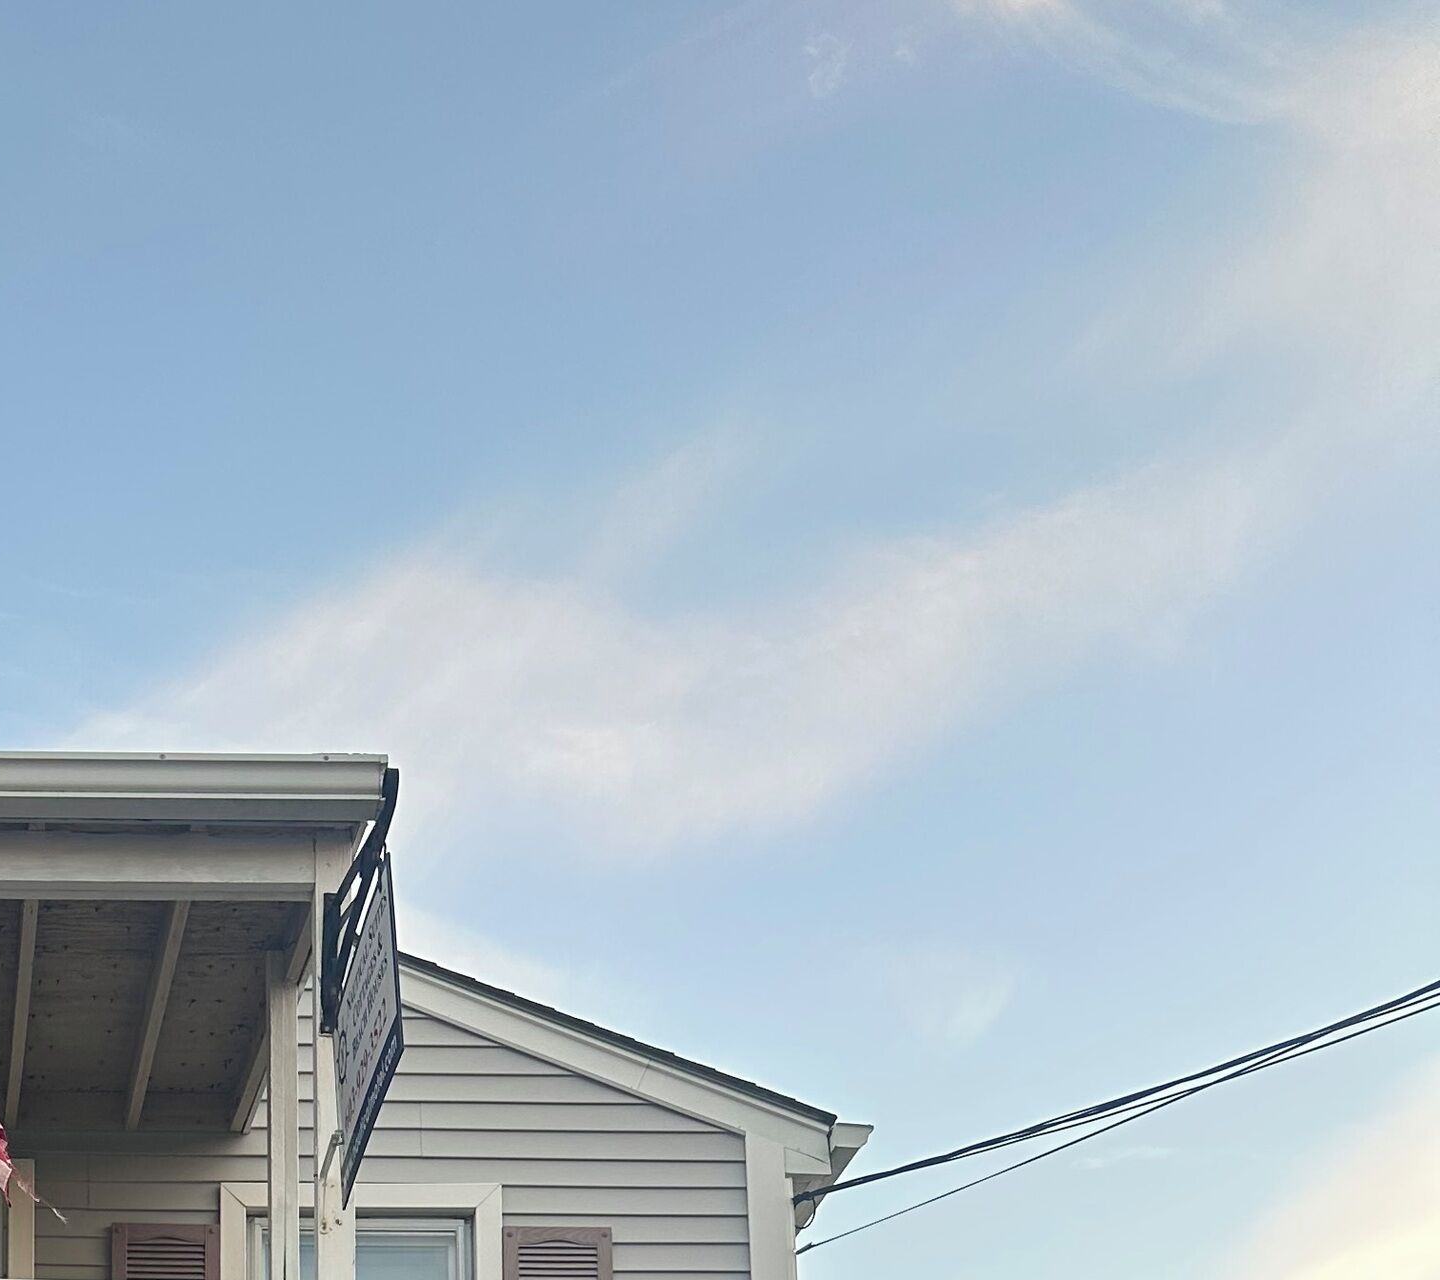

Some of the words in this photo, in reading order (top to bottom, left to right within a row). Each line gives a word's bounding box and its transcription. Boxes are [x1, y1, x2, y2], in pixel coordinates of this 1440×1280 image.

[368, 894, 387, 942] SUITES
[352, 1006, 368, 1060] BEACH
[367, 956, 388, 1014] HOUSES
